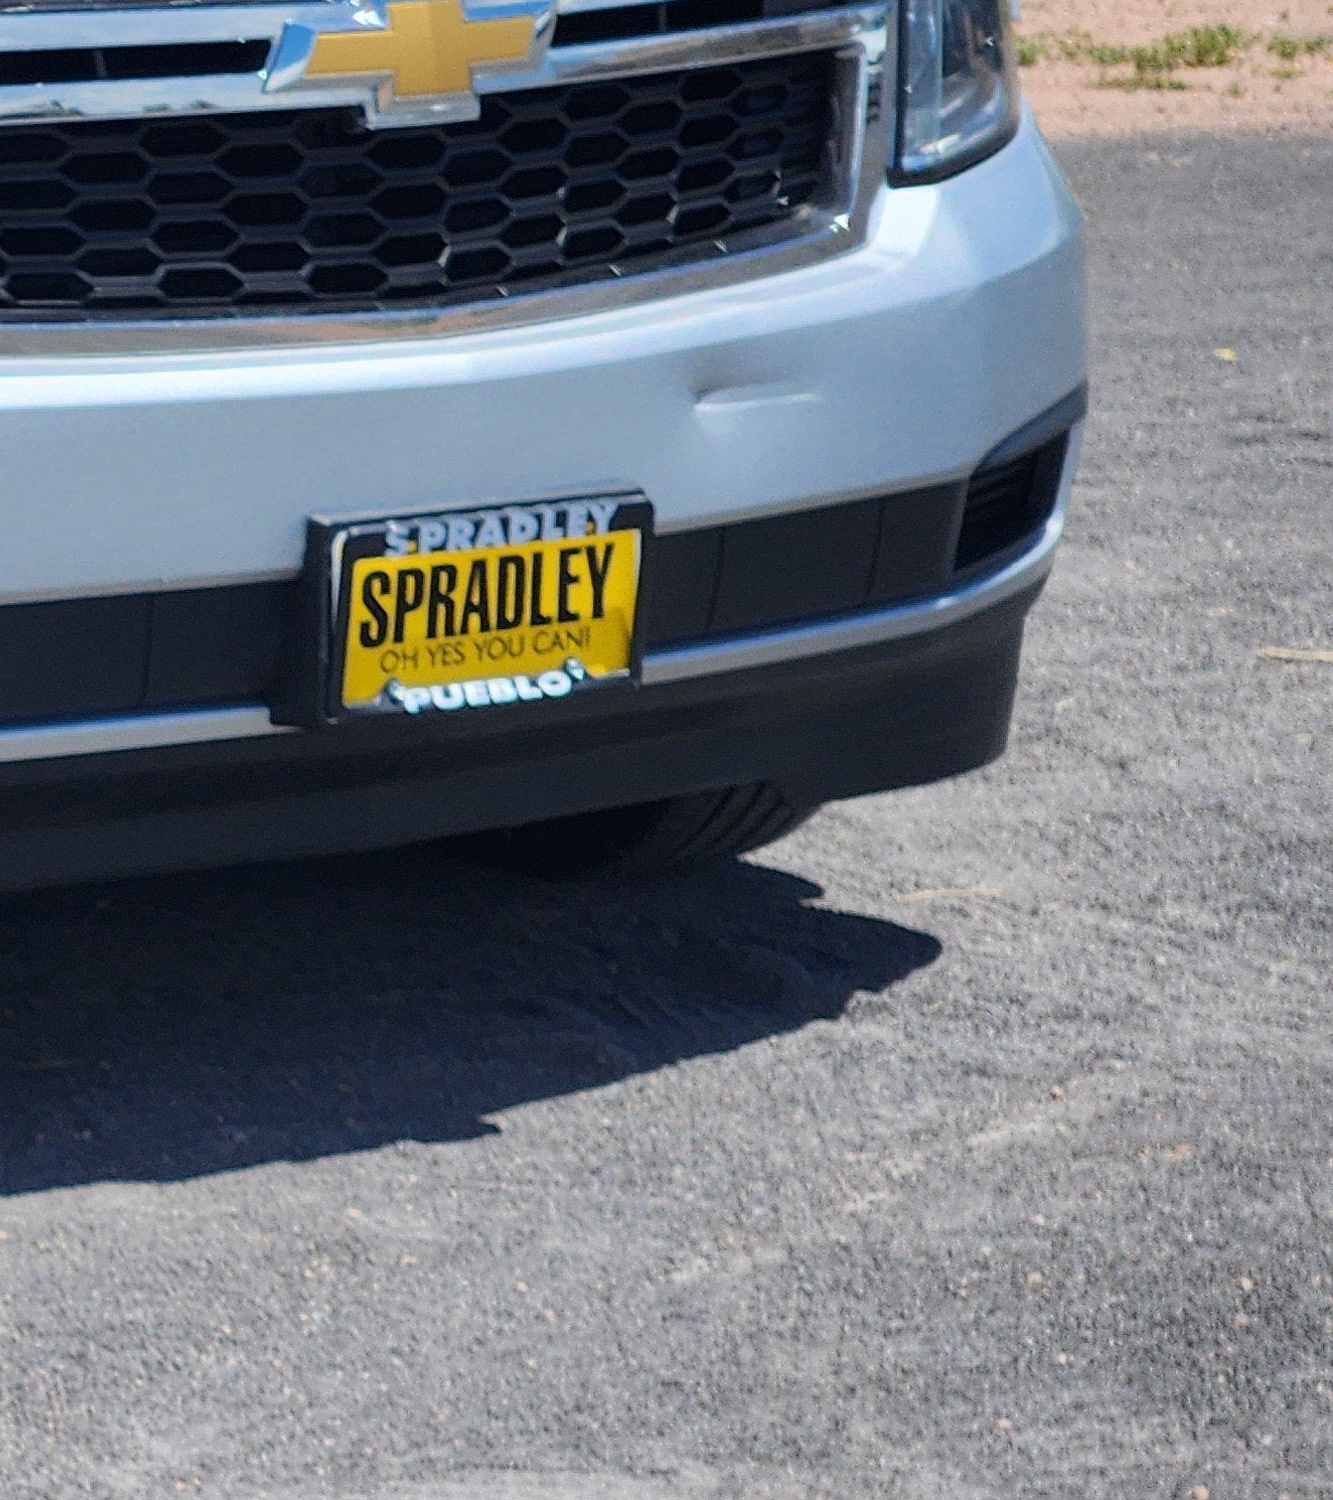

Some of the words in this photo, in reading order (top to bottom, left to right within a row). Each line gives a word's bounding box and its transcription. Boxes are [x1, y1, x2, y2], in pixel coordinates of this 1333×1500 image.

[385, 501, 618, 557] SPRADLEY
[359, 543, 615, 648] SPRADLEY
[379, 649, 420, 674] OH
[427, 641, 466, 668] YES
[473, 635, 526, 663] YOU
[398, 669, 573, 716] PUEBLO
